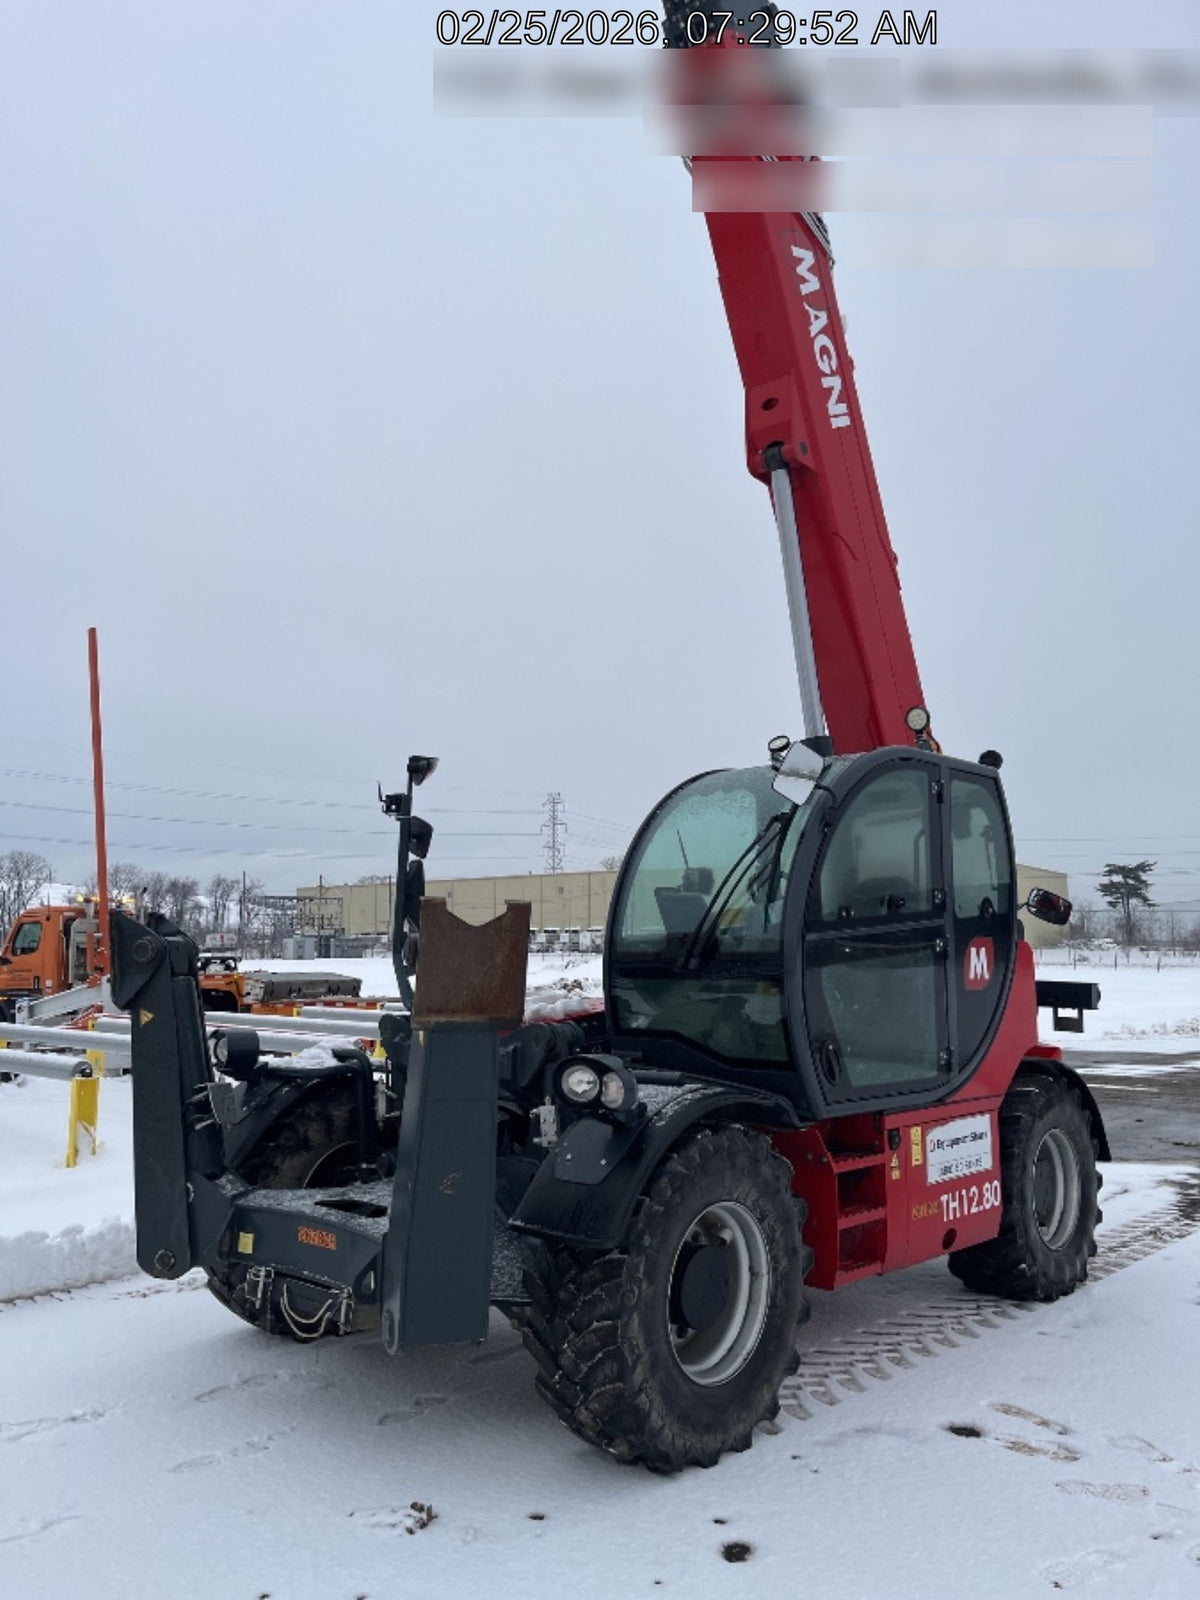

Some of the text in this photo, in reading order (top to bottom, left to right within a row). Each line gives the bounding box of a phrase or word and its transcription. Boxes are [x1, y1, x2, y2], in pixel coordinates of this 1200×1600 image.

[790, 244, 852, 429] MAGNI
[969, 946, 989, 980] M
[940, 1179, 1001, 1223] TH12.80
